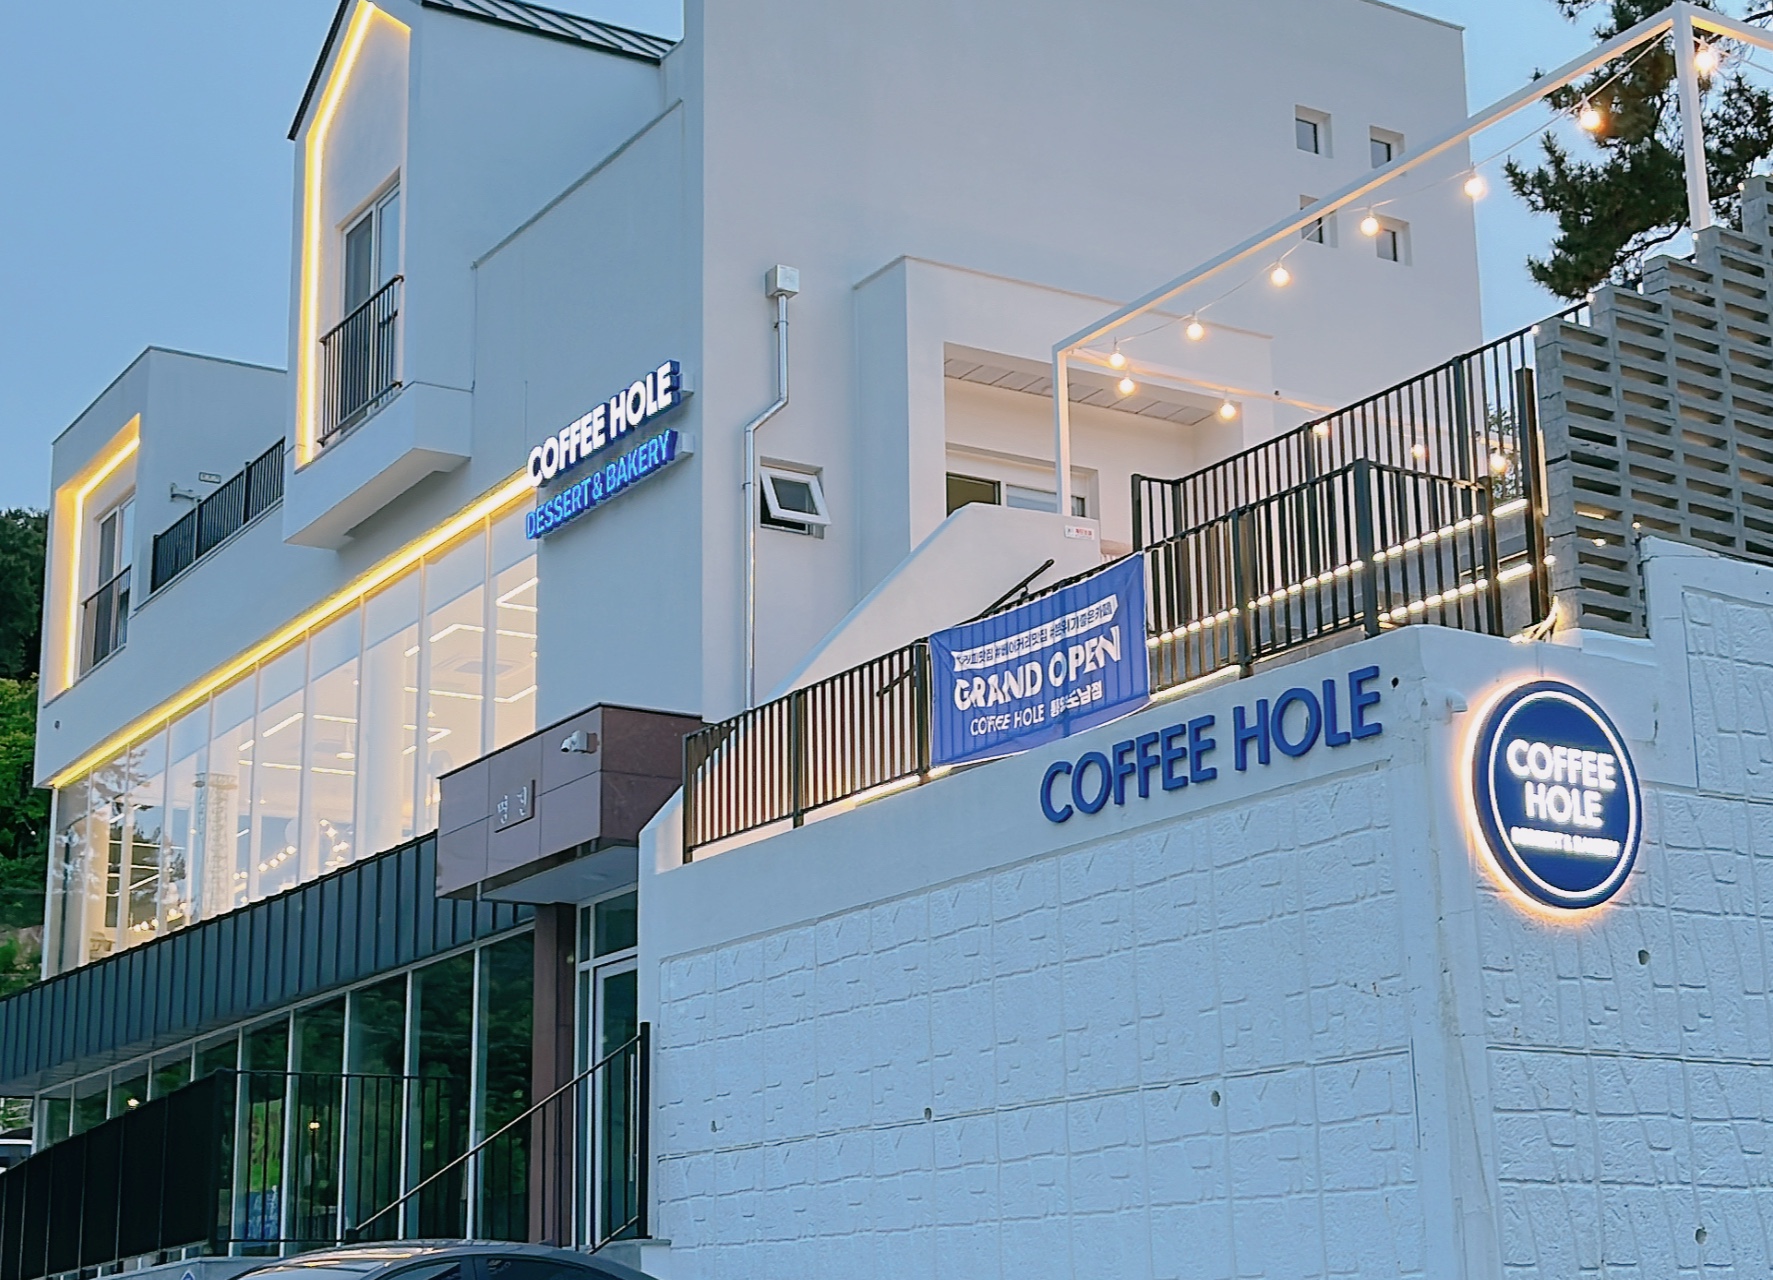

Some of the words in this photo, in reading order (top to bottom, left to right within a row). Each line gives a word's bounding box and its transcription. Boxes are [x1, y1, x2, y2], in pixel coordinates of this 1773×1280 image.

[527, 403, 606, 487] COFFEE
[610, 360, 675, 439] HOLE
[526, 477, 592, 539] DESSERT
[591, 472, 604, 500] &
[605, 429, 671, 492] BAKERY
[954, 661, 1043, 711] GRAND
[1048, 625, 1122, 687] OPEN
[970, 713, 1011, 736] COFFEE
[1013, 704, 1045, 729] HOLE
[1040, 714, 1217, 823] COFFEE
[1233, 666, 1382, 771] HOLE
[1506, 738, 1617, 791] COFFEE
[1525, 780, 1605, 828] HOLE
